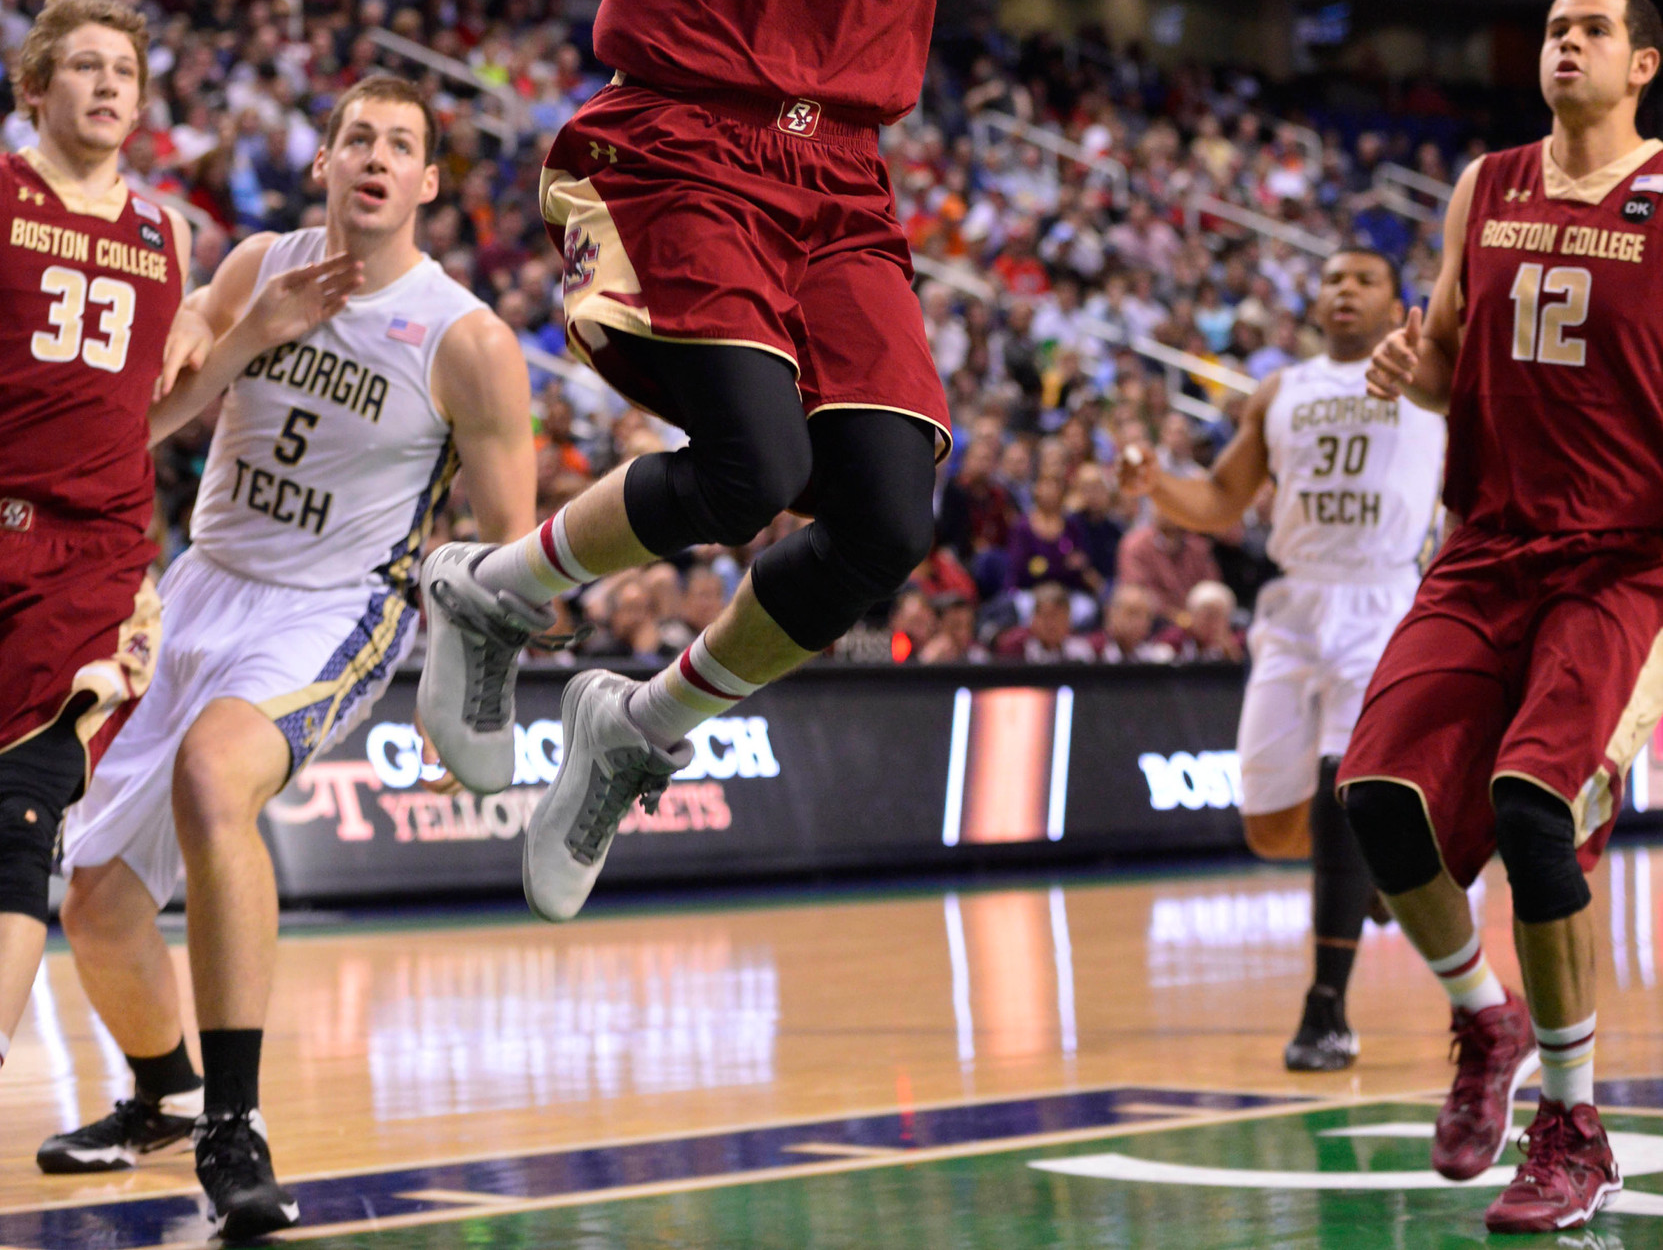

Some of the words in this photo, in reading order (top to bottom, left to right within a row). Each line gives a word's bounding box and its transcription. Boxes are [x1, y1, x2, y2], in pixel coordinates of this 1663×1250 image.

[1624, 202, 1649, 216] DK
[10, 217, 90, 262] BOSTON
[96, 238, 168, 284] COLLEGE
[1481, 219, 1558, 253] BOSTON
[1560, 226, 1646, 263] COLLEGE
[31, 265, 136, 373] 33
[1509, 262, 1592, 367] 12
[273, 406, 321, 468] 5
[1313, 435, 1370, 478] 30
[230, 457, 333, 537] TECH
[1298, 491, 1382, 526] TECH
